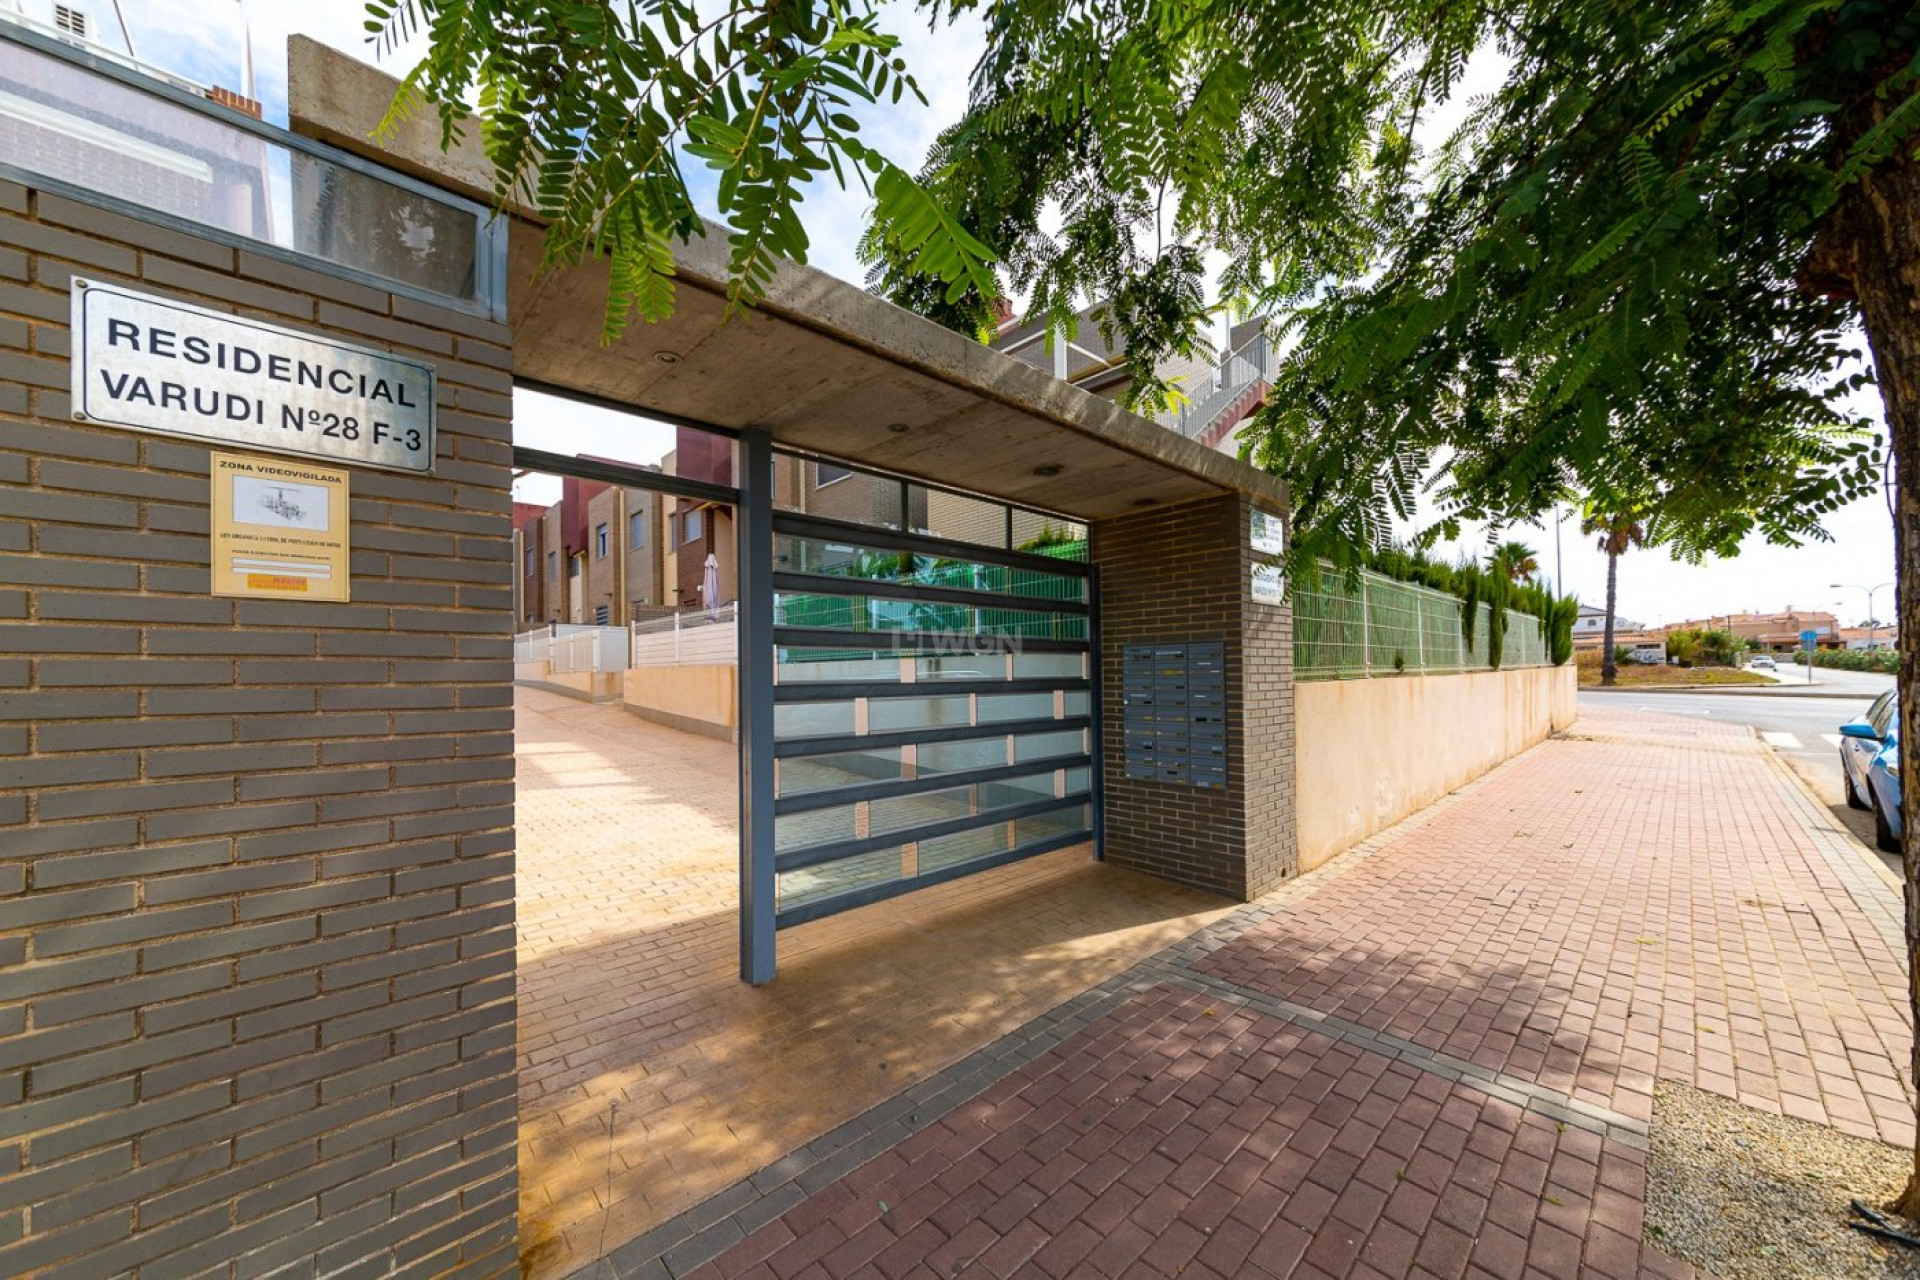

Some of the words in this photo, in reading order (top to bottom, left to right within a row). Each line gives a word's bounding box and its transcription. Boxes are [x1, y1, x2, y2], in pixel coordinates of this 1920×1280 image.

[108, 317, 416, 408] RESIDENCIAL
[100, 369, 264, 425] VARUDI
[281, 404, 360, 442] Nº28
[373, 422, 422, 451] F-3
[219, 460, 253, 472] ZONA
[256, 466, 342, 483] VIDEOVIGILADA
